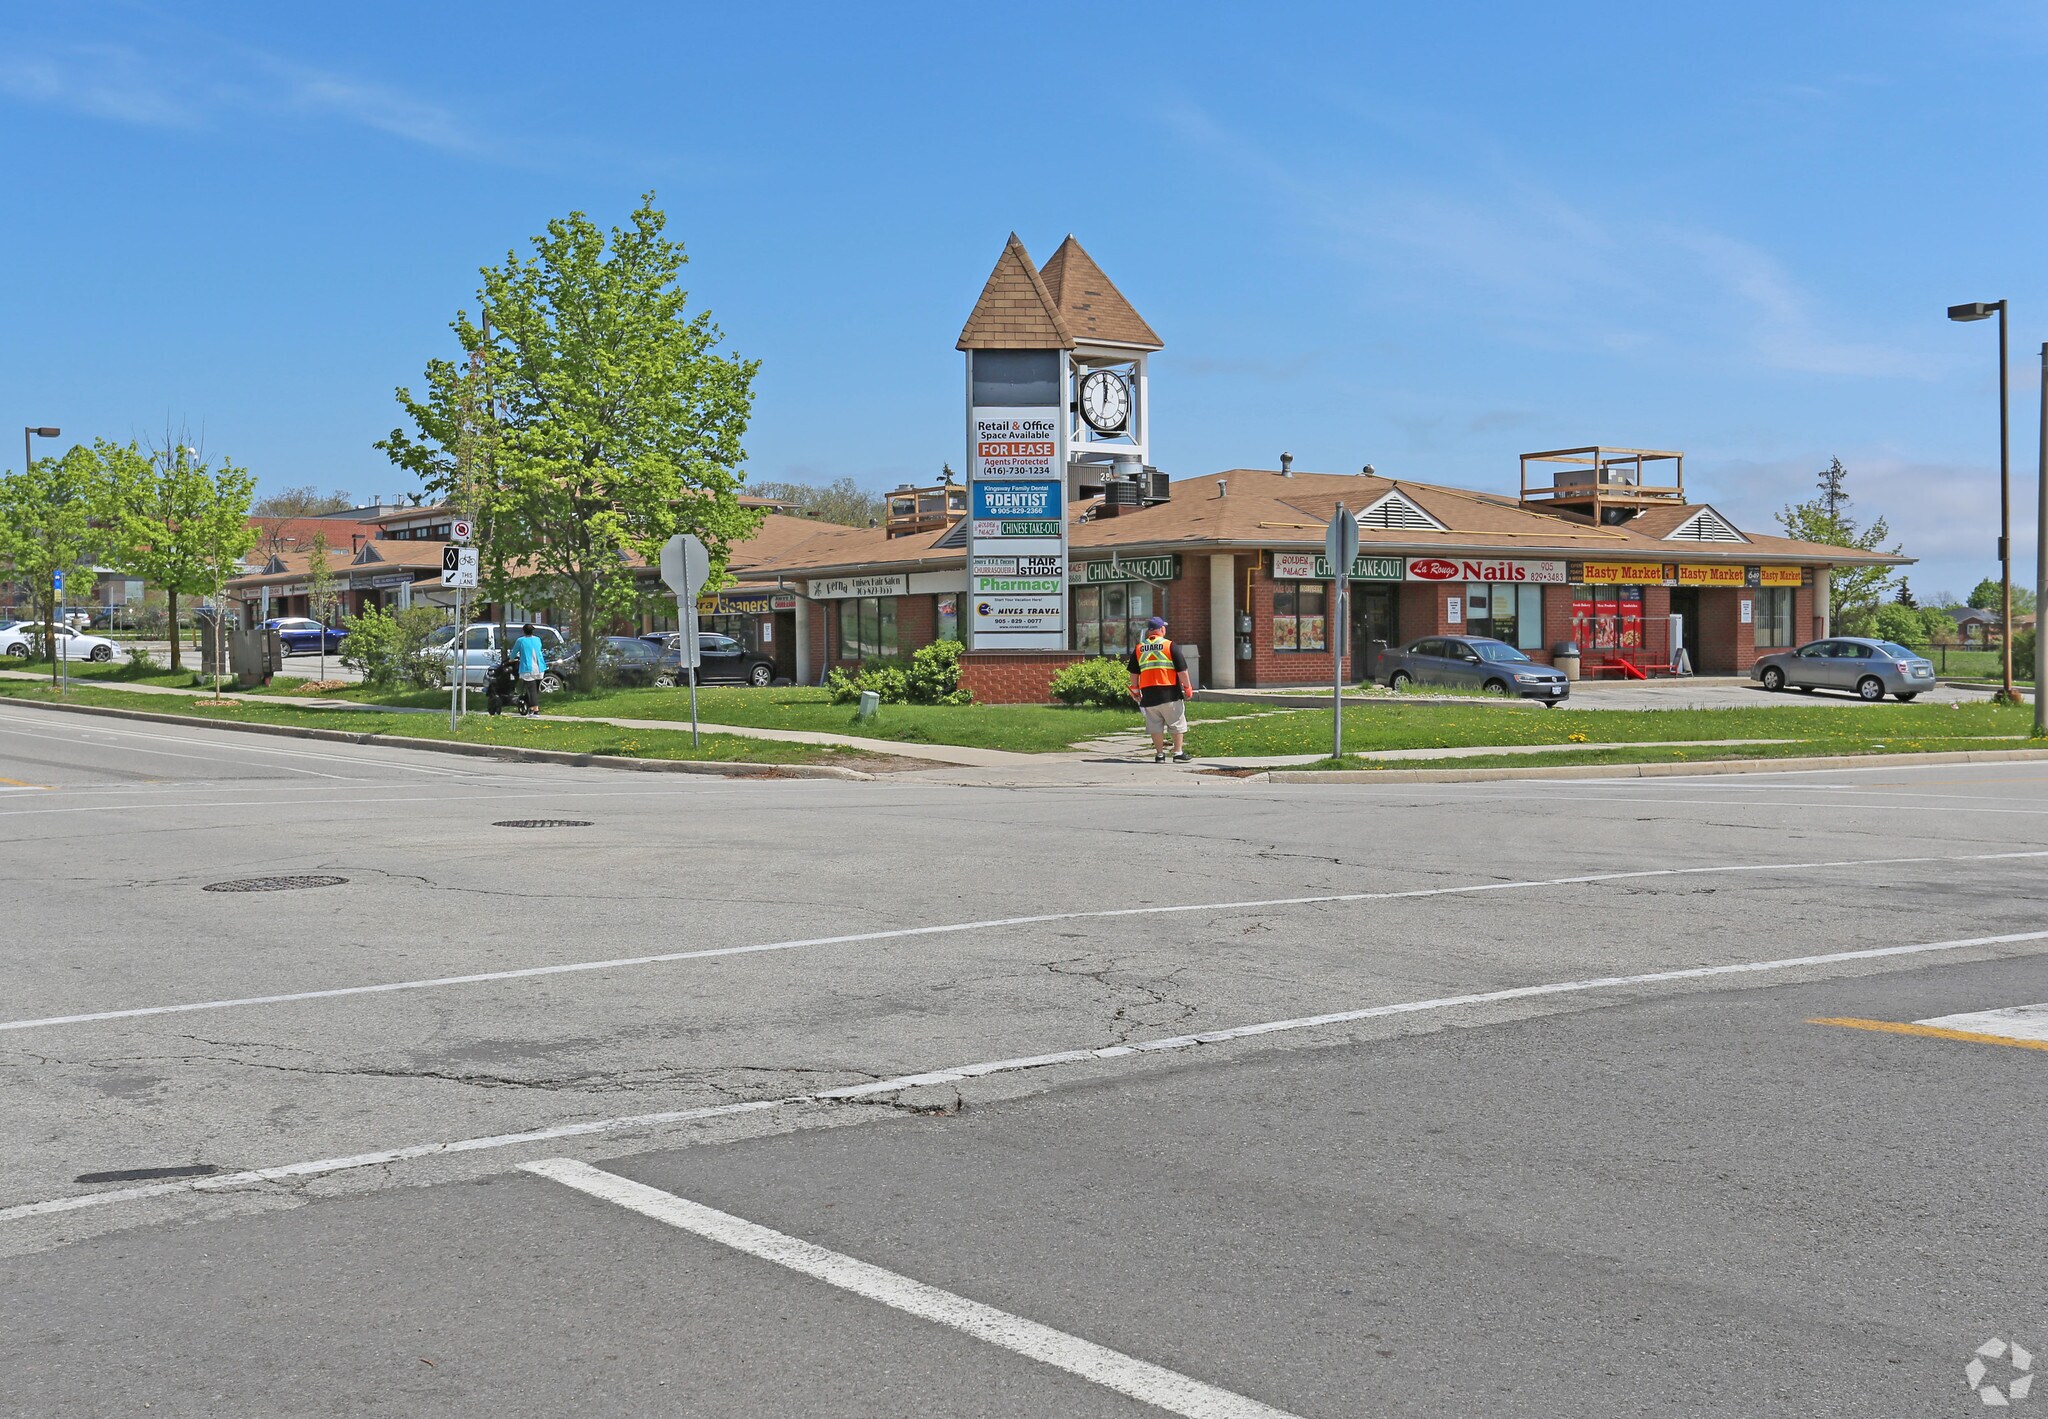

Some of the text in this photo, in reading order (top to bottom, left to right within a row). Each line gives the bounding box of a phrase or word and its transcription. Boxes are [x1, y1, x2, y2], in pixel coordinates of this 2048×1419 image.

[978, 420, 1055, 431] Retail & Office
[981, 431, 1050, 441] Space Available
[982, 444, 1051, 455] FOR LEASE
[984, 458, 1011, 467] Agents
[983, 466, 1050, 476] (416)-730-1234
[995, 493, 1048, 506] DENTIST
[1001, 522, 1028, 534] CHINESE
[1028, 557, 1056, 566] HAIR
[1281, 555, 1309, 565] GOLDEN
[1282, 567, 1308, 576] PALACE
[1413, 561, 1526, 581] La Rouge Nails
[1540, 562, 1554, 571] 905
[1585, 565, 1661, 581] Hasty Market
[1680, 567, 1744, 582] Hasty Market
[1761, 570, 1779, 582] Hasty
[1779, 571, 1801, 580] Market
[884, 576, 901, 585] Salon
[980, 577, 1060, 593] Pharmacy
[718, 598, 769, 613] Cleaners
[1139, 643, 1164, 652] GUARD
